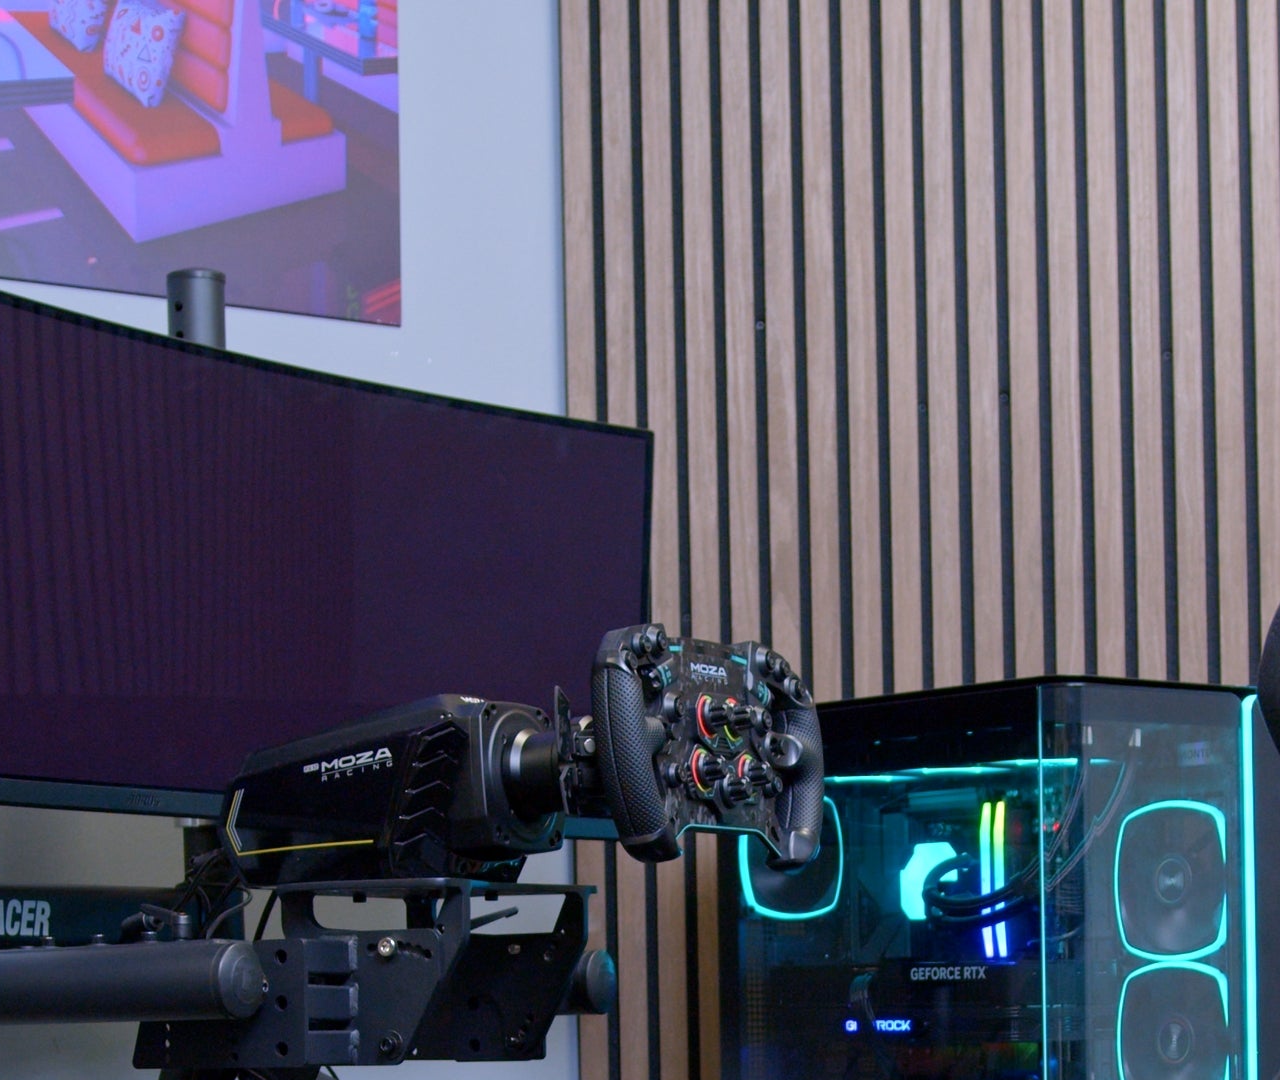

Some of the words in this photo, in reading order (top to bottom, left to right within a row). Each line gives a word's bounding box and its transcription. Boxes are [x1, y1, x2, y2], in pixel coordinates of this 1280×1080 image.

[690, 661, 728, 677] MOZA
[321, 747, 393, 773] MOZA
[321, 760, 393, 783] RACING
[910, 966, 961, 981] GEFORCE
[963, 965, 987, 980] RTX
